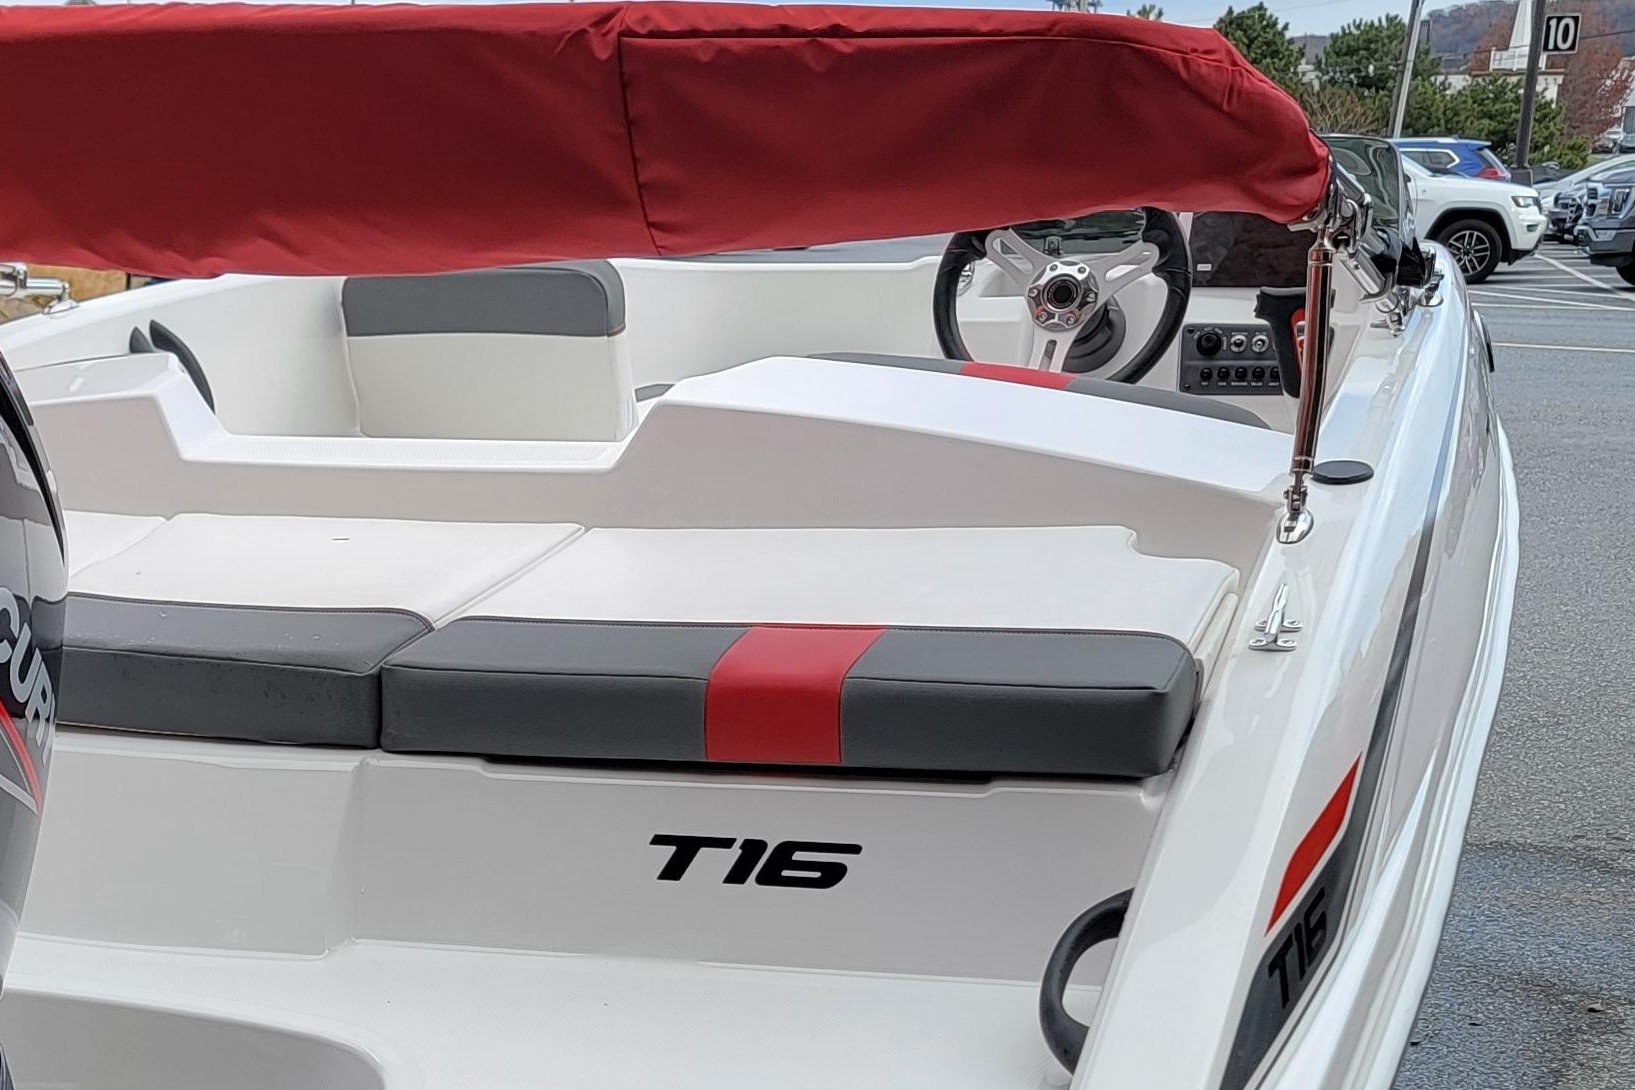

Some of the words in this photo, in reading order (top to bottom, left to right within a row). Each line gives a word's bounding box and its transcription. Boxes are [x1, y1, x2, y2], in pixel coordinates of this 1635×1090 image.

[1548, 17, 1576, 51] 10
[648, 833, 863, 889] T16
[1267, 886, 1329, 1010] T16
